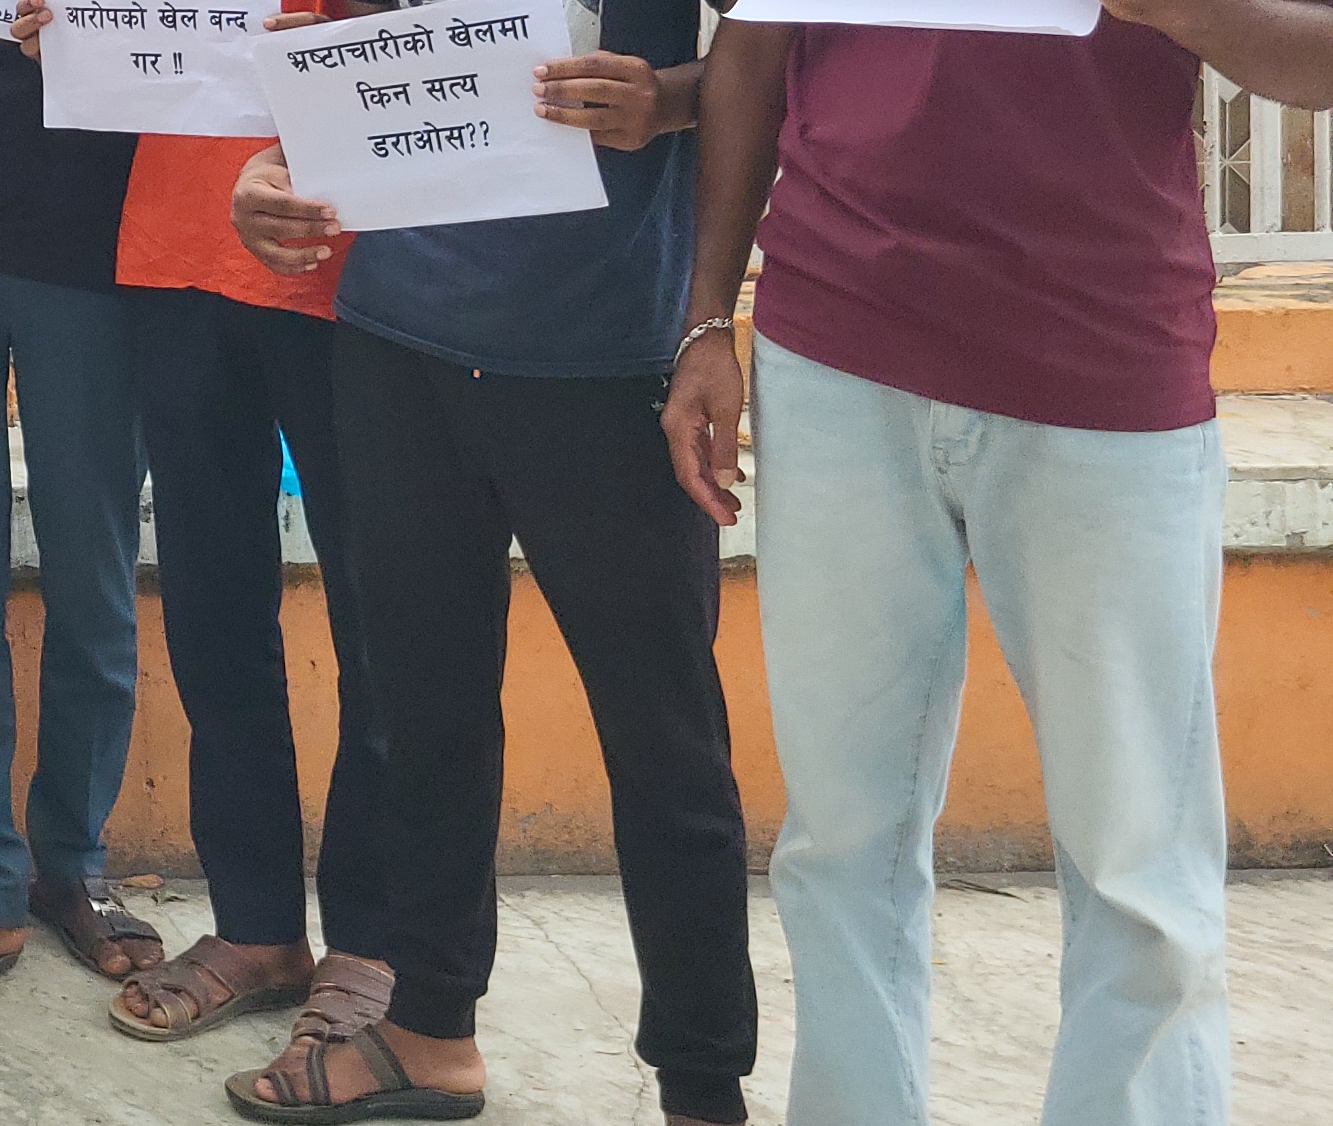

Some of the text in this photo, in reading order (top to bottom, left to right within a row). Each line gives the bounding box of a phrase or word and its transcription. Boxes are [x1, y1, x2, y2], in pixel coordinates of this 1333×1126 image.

[65, 0, 248, 33] आरोपको खेल बन्द
[286, 13, 530, 74] भ्रष्टाचारीको खेलमा
[130, 52, 162, 75] गर
[356, 72, 479, 112] किन सत्य
